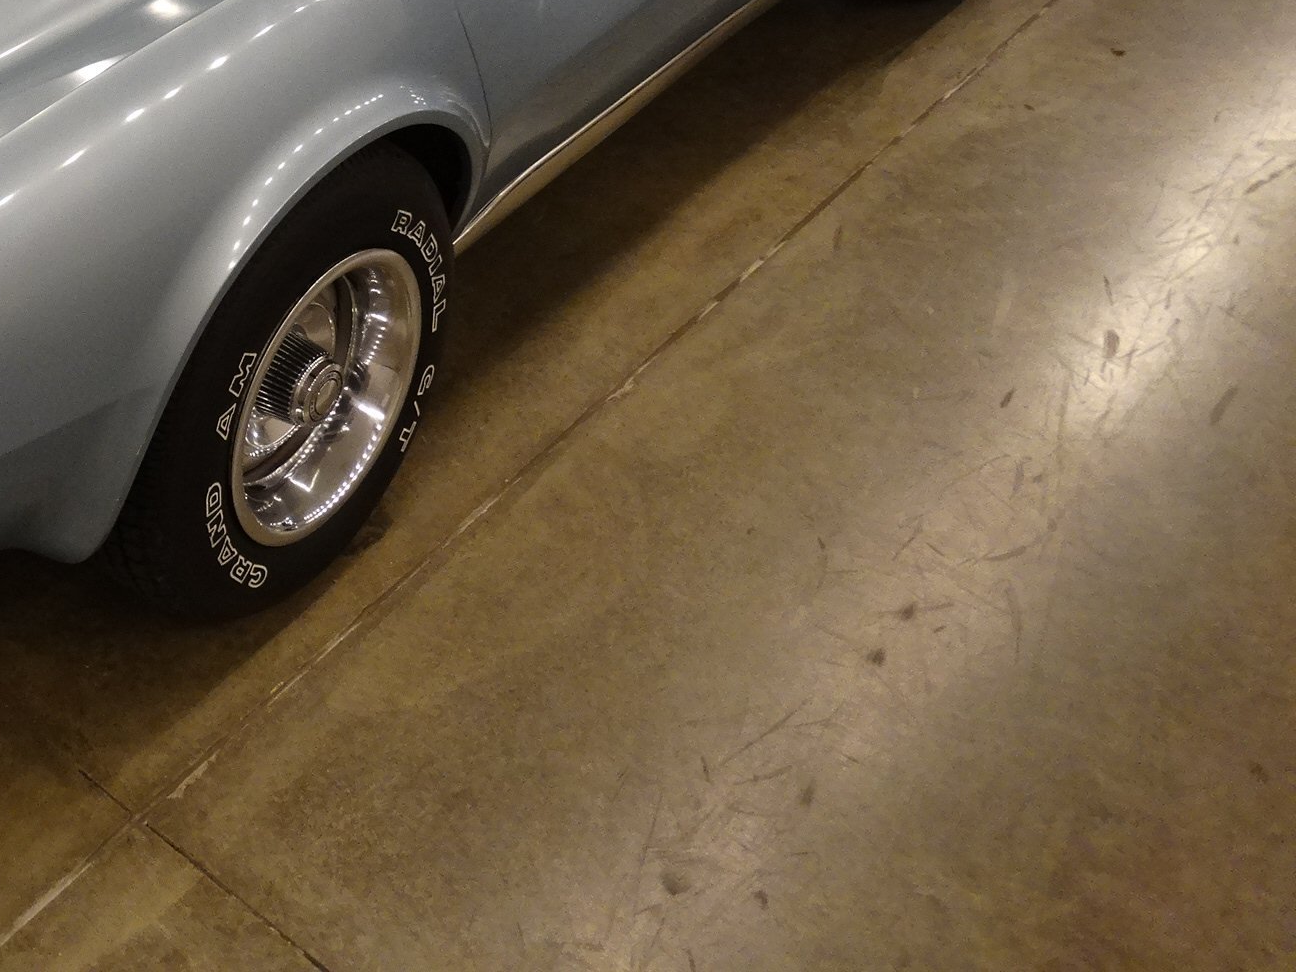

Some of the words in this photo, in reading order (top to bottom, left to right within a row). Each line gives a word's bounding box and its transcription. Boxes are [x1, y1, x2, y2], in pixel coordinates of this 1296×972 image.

[391, 209, 447, 333] RADIAL
[215, 352, 258, 441] AM
[205, 481, 268, 588] GRAND
